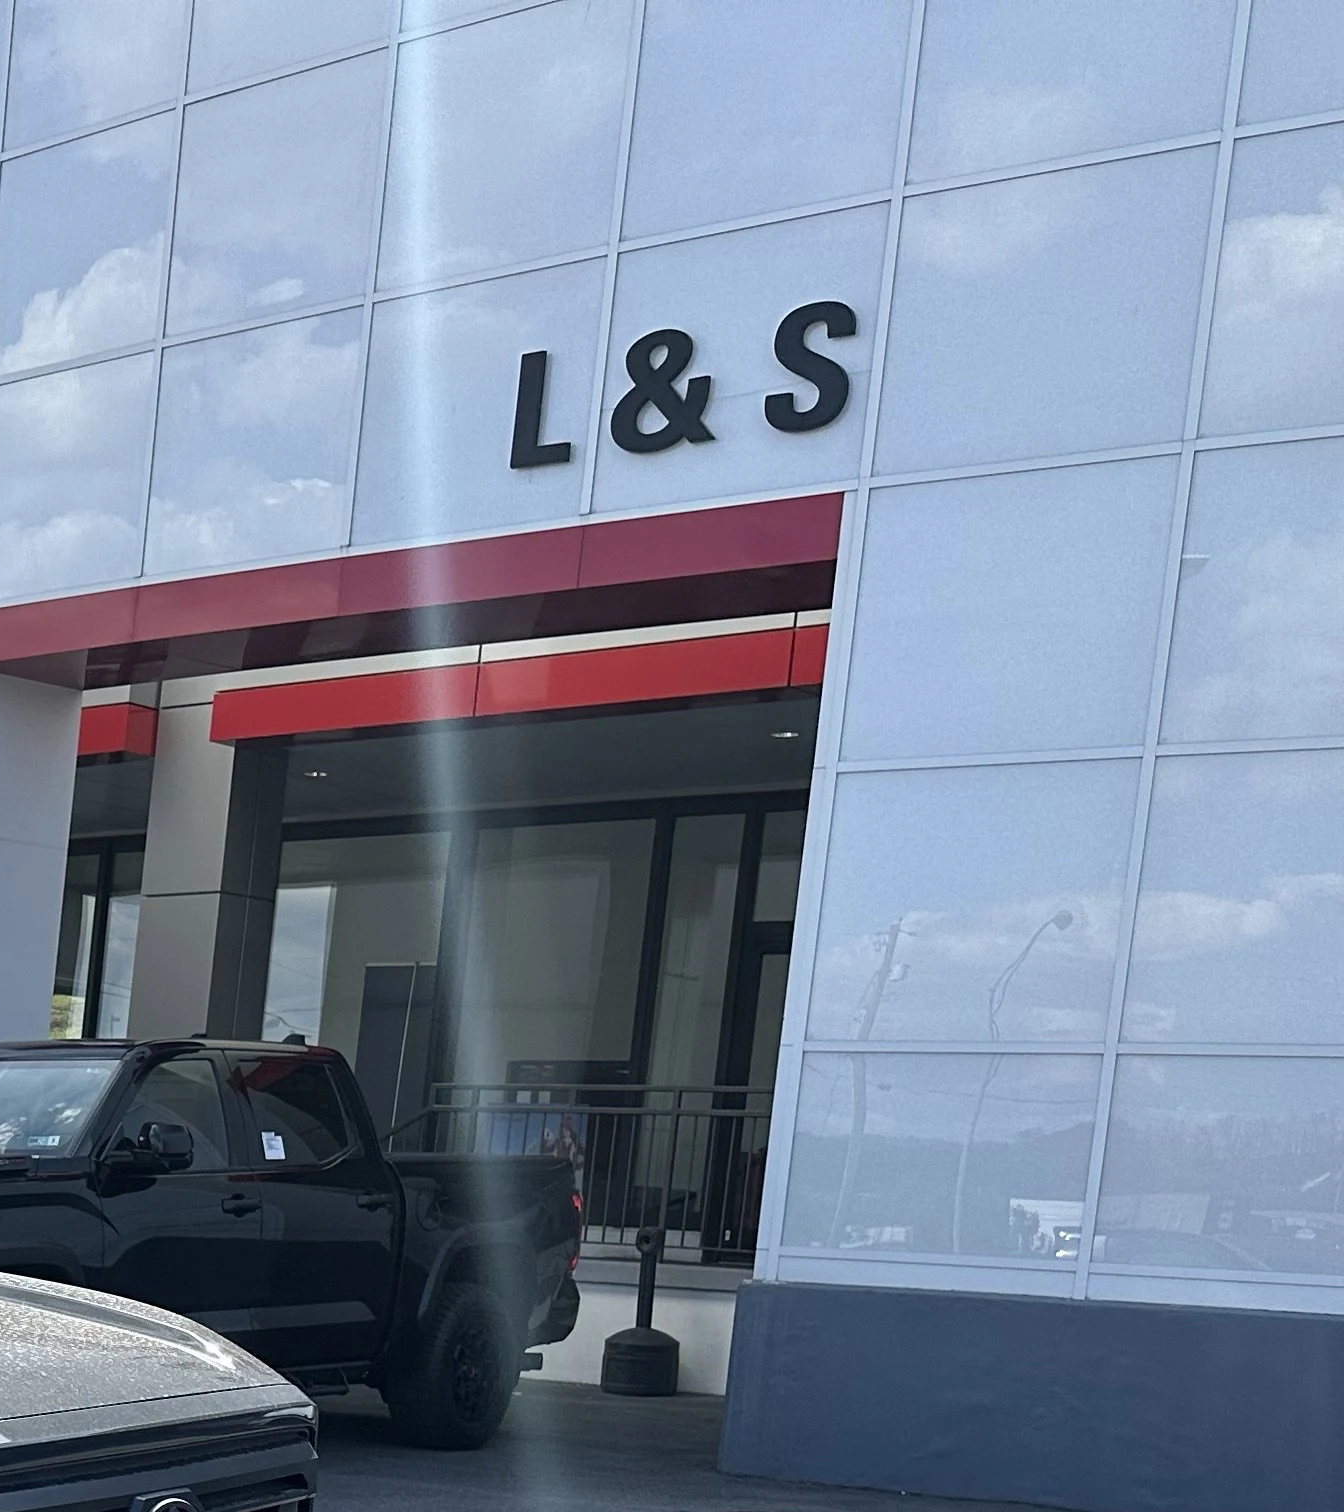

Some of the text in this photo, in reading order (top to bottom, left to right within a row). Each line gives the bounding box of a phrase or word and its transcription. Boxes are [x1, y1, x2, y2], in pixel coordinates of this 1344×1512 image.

[510, 300, 856, 469] L & S
